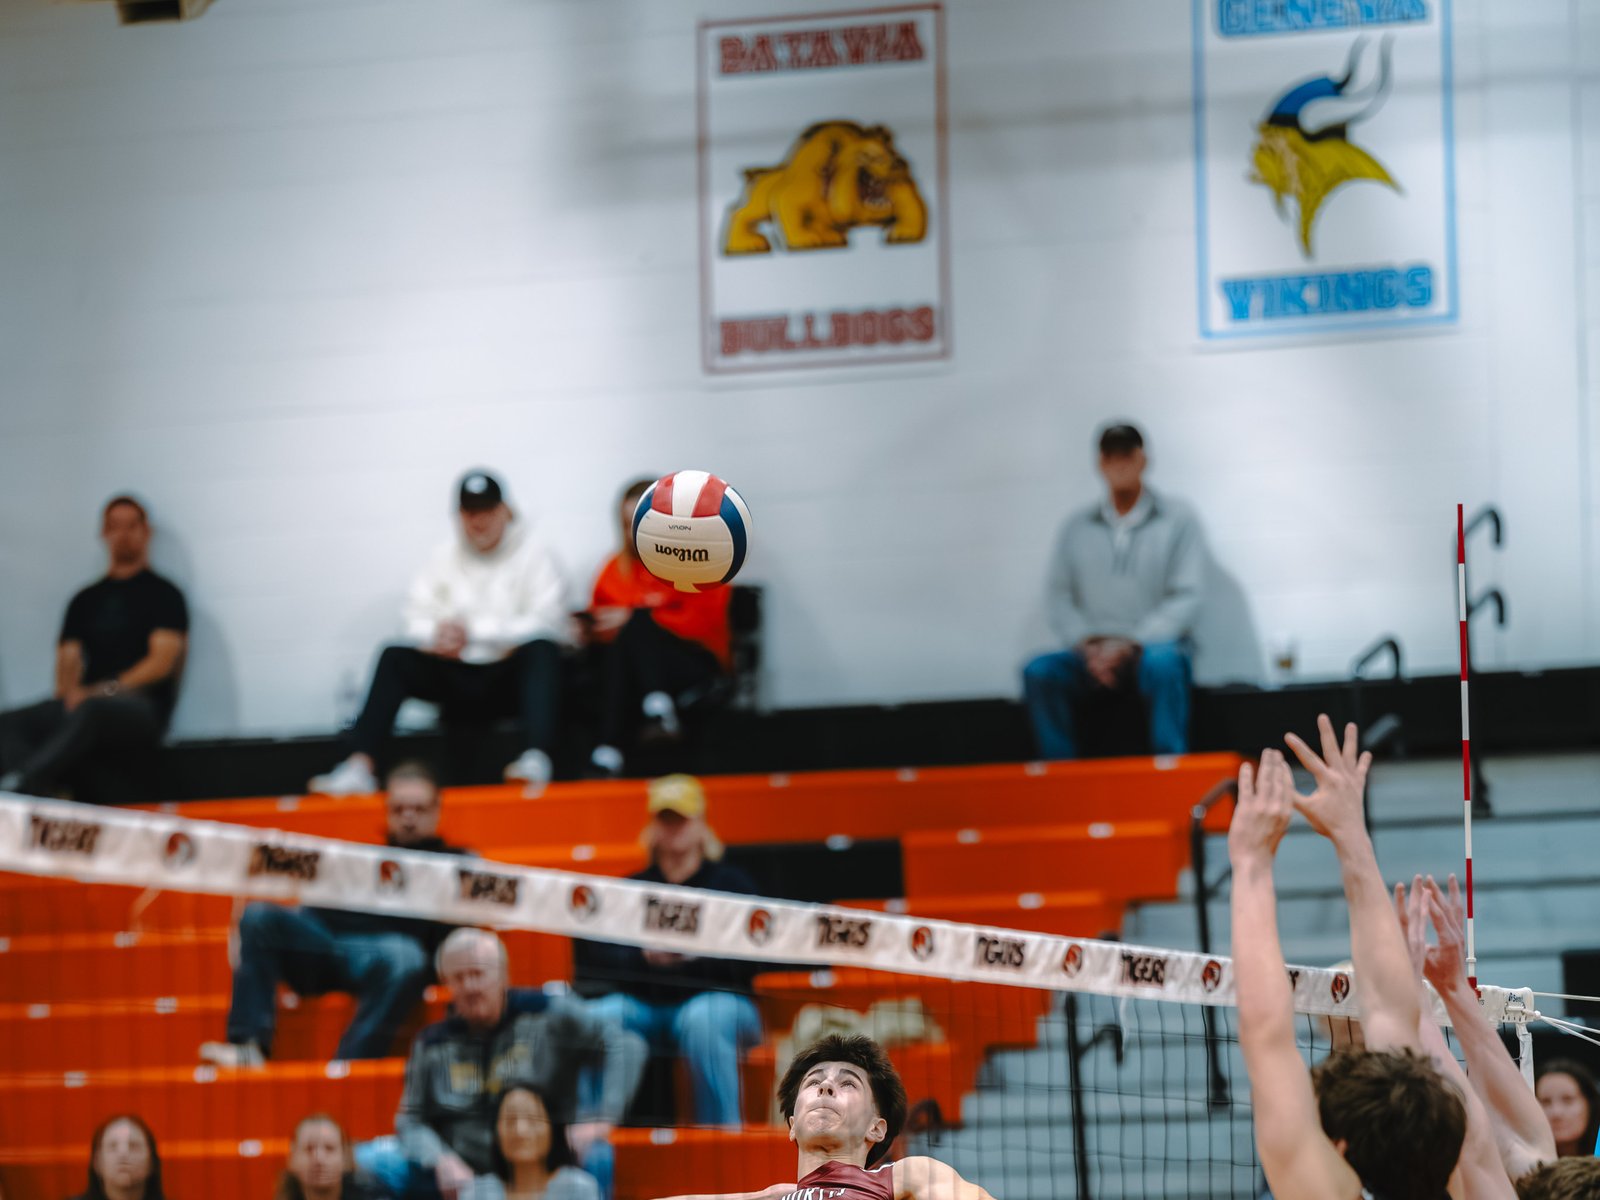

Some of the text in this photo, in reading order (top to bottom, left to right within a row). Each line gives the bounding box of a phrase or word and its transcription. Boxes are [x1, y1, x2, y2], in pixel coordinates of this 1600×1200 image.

[719, 20, 925, 74] BATAVIA
[1221, 267, 1433, 320] VIKINGS
[719, 305, 934, 357] BULLDOGS
[654, 543, 710, 562] Wilson
